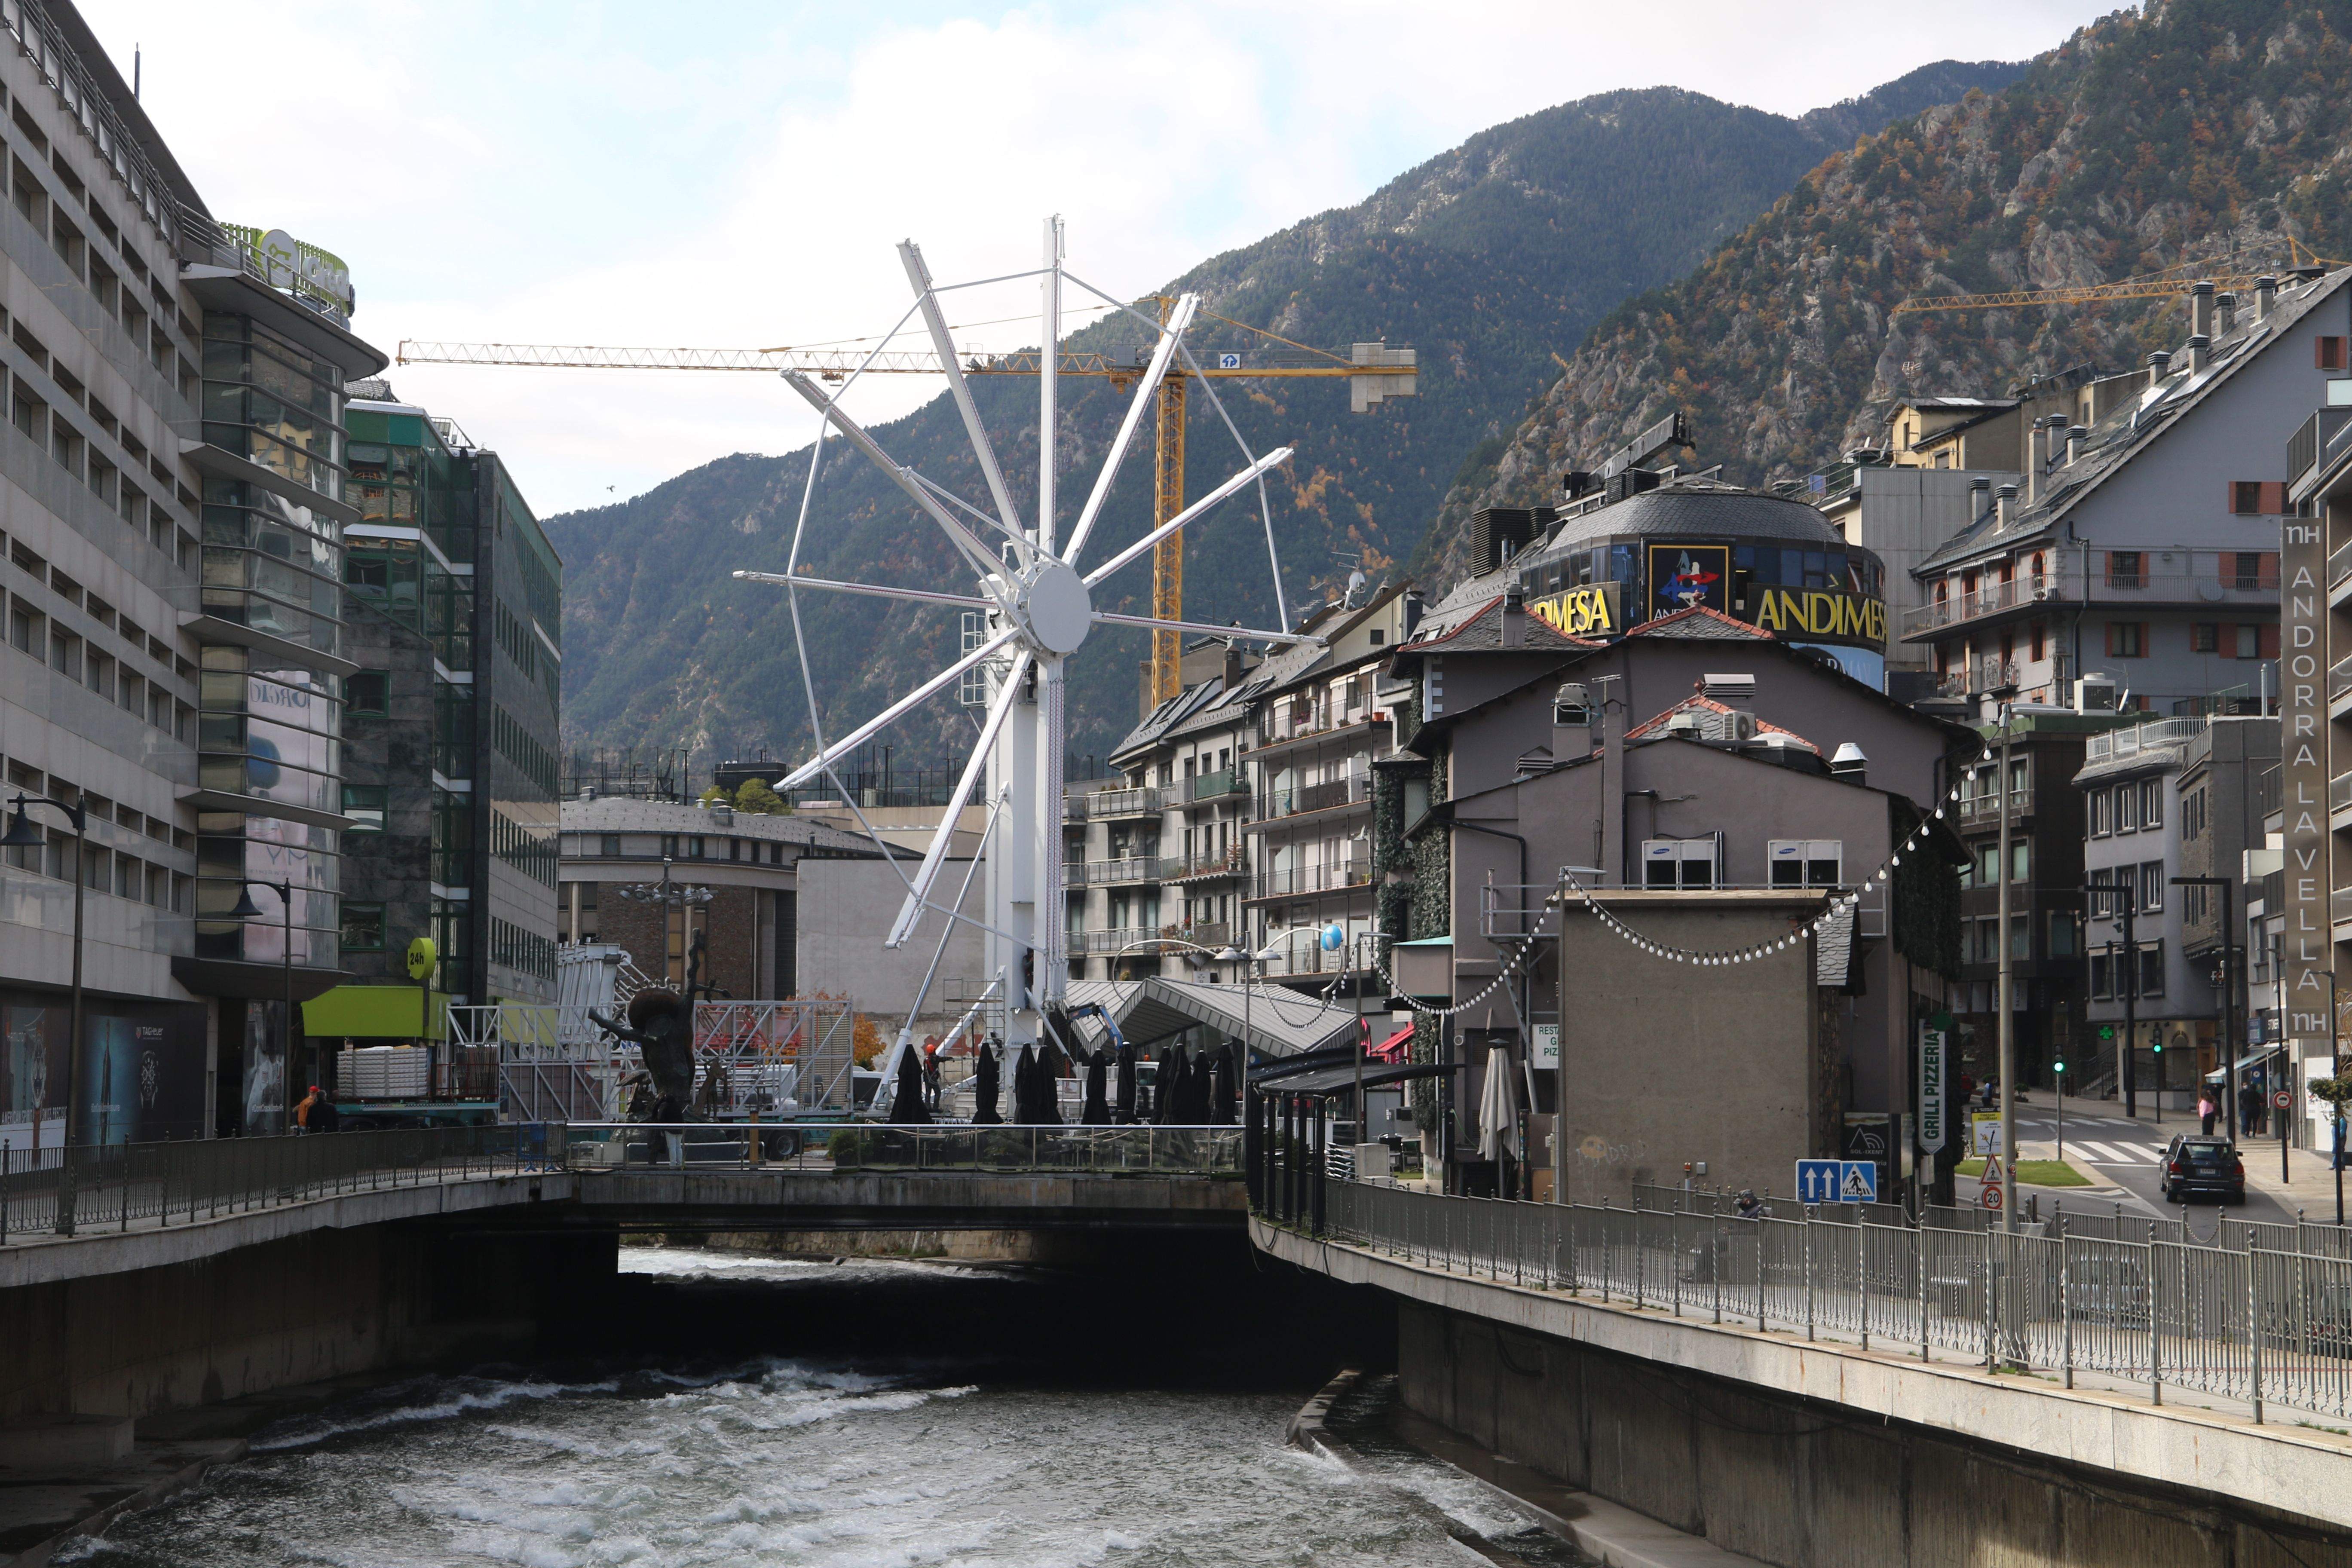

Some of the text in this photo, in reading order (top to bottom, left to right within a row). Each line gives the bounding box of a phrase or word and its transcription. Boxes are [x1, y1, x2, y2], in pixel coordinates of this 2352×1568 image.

[1534, 588, 1611, 634] DIMESA
[1755, 589, 1889, 645] ANDIMESA
[2291, 566, 2316, 766] ANDORRA
[2295, 849, 2319, 990] VELLA
[410, 952, 424, 965] 24h
[1544, 1047, 1558, 1056] PIZ
[1924, 1032, 1939, 1140] GRILL PIZZERIA
[1988, 1194, 1999, 1203] 20
